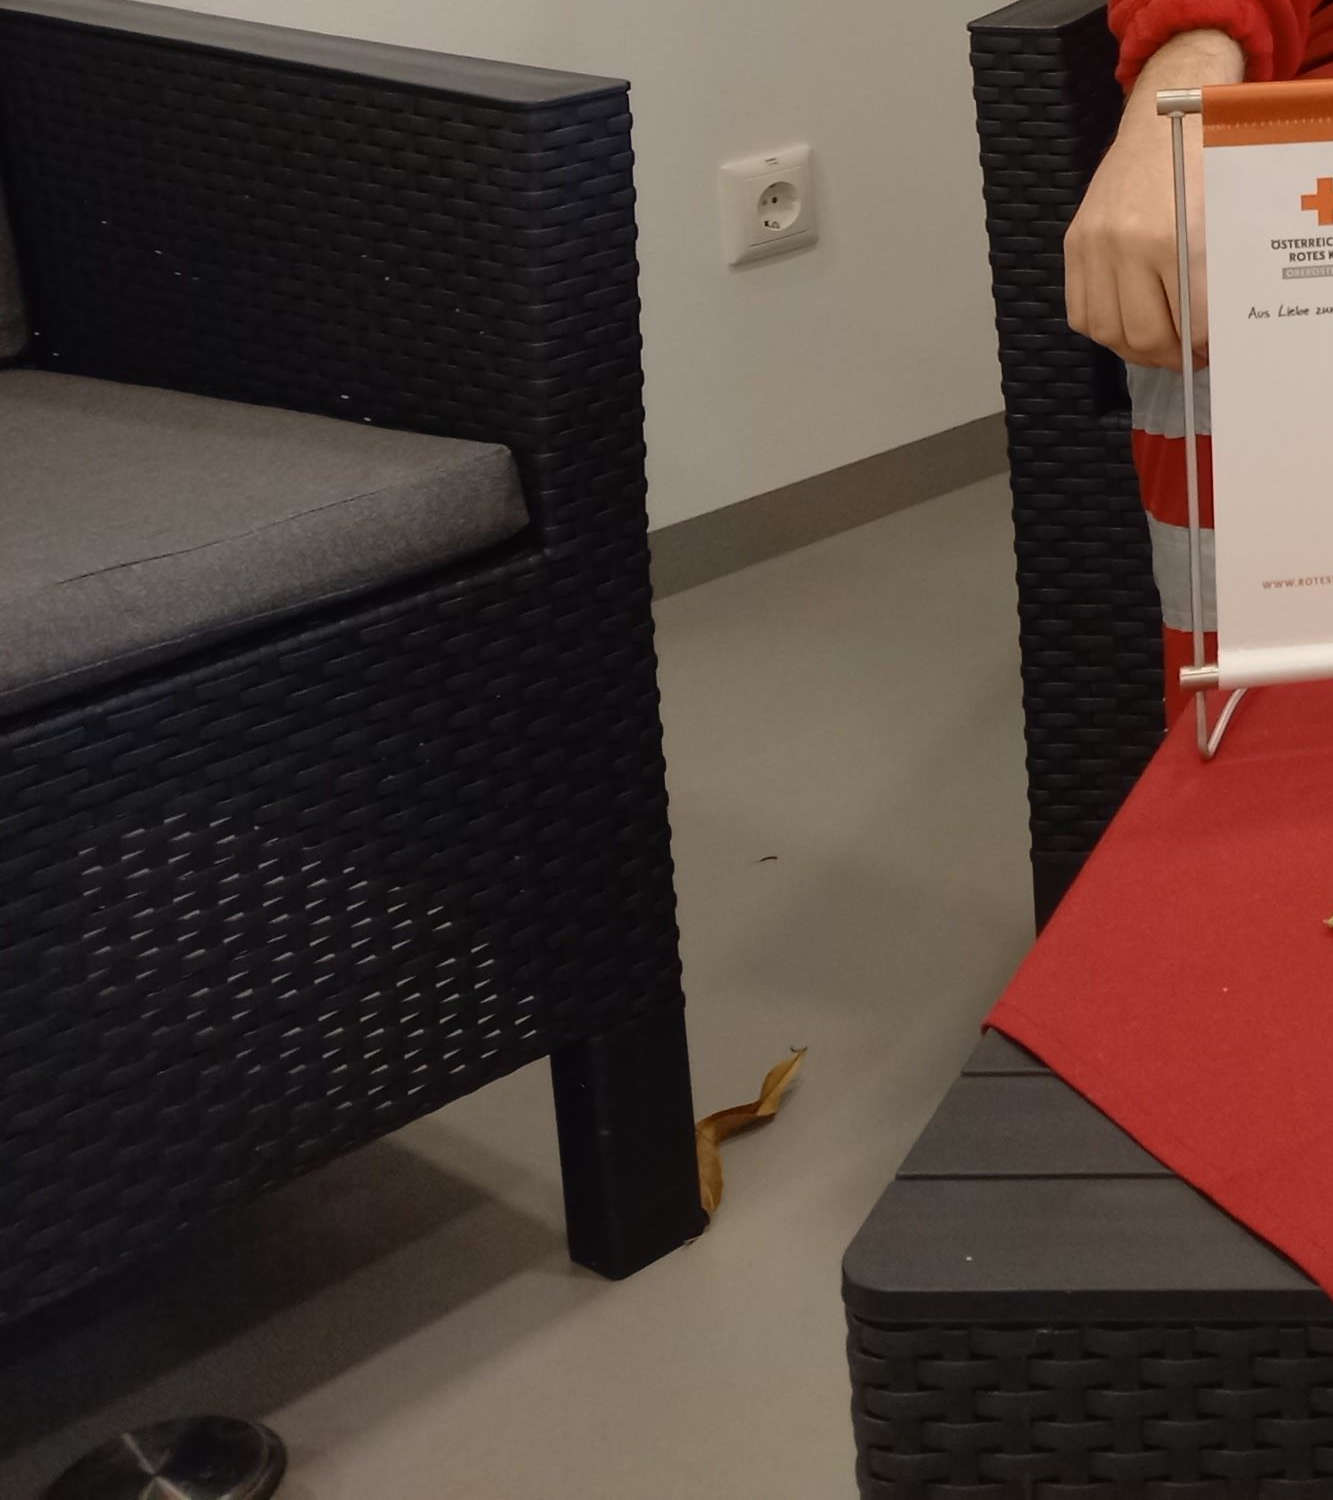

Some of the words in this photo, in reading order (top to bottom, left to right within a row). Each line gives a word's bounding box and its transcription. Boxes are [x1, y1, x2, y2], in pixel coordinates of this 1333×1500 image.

[1288, 250, 1326, 263] ROTES
[1248, 306, 1271, 319] Aus
[1277, 304, 1310, 318] Liebe
